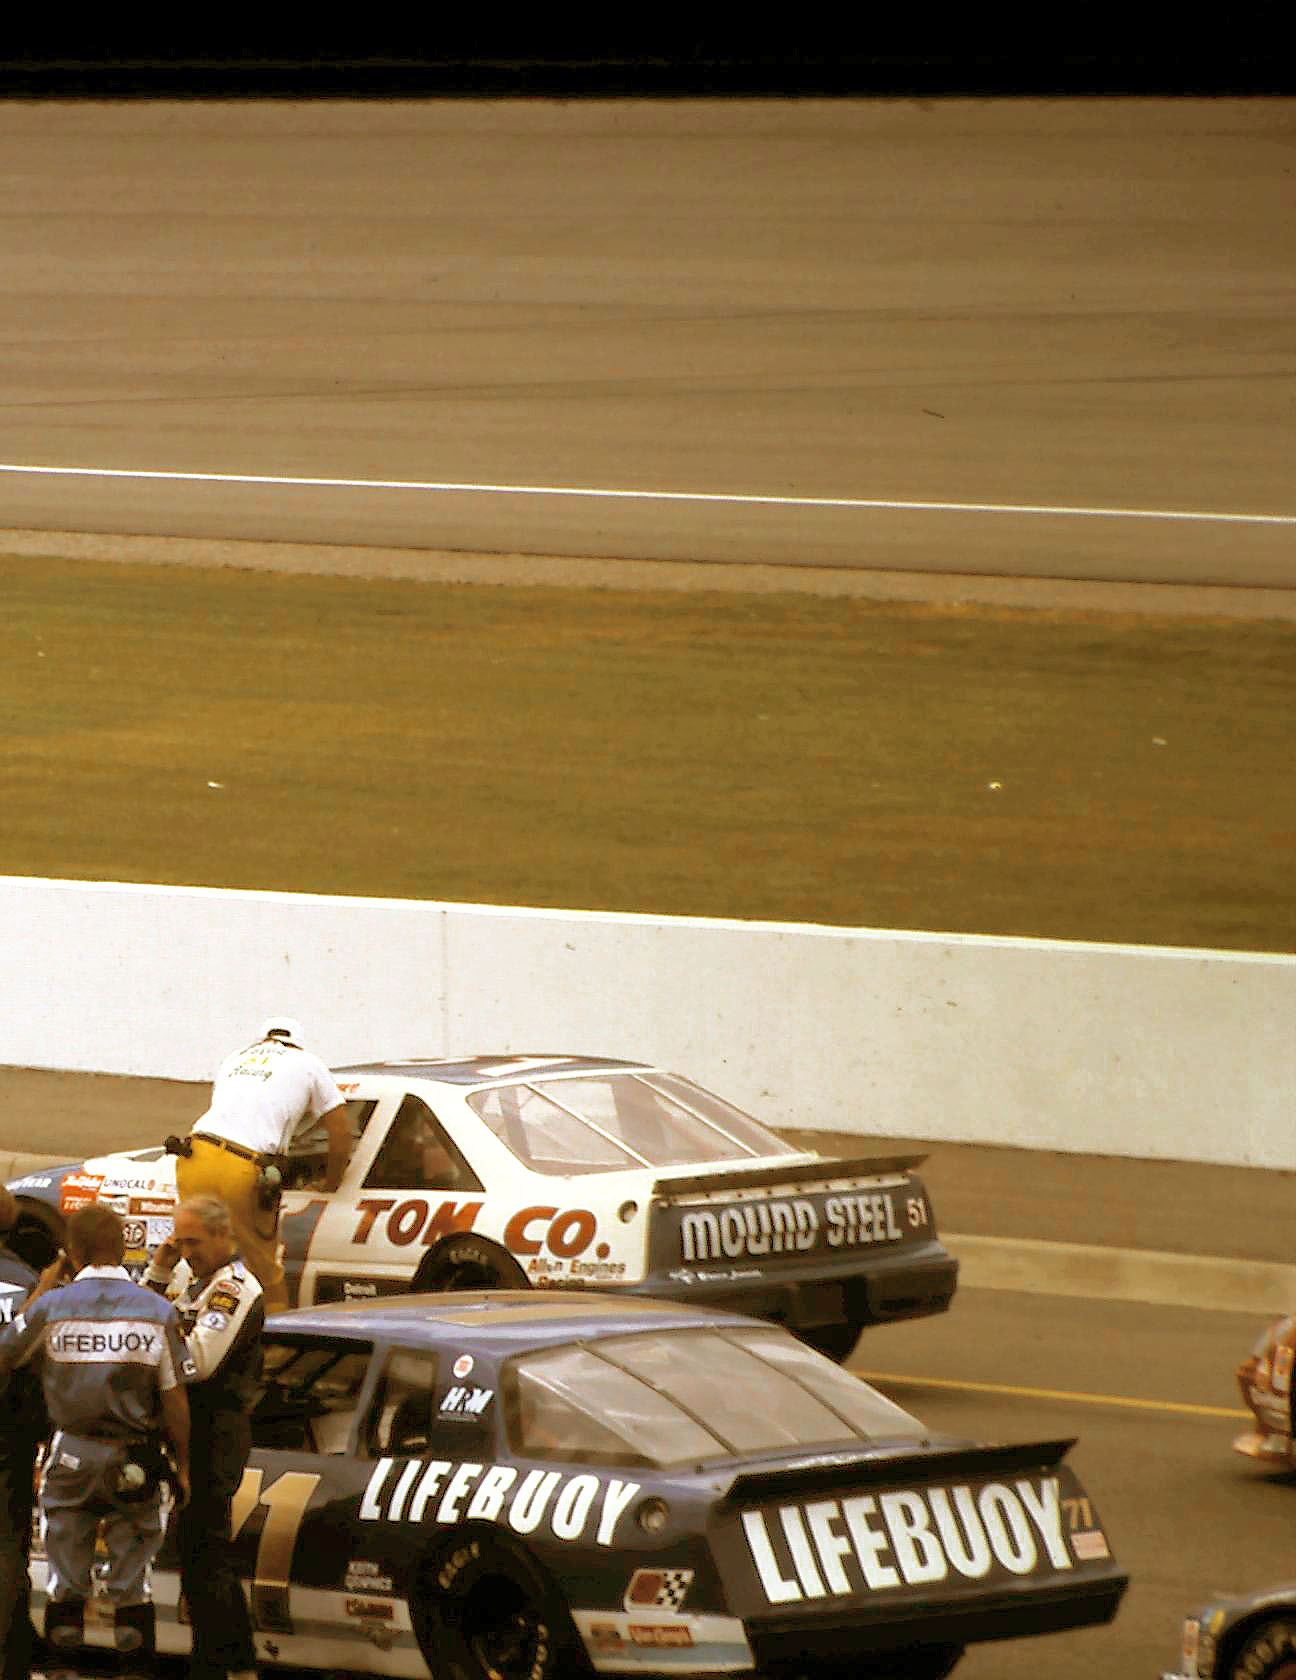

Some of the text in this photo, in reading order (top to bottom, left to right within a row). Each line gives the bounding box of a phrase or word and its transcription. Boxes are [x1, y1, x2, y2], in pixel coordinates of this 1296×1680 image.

[103, 1177, 149, 1190] UNOCAL
[906, 1198, 929, 1228] 51
[352, 1198, 611, 1260] TOM CO.
[680, 1194, 903, 1261] MOUND STEEL
[358, 1456, 642, 1546] LIFEBUOY
[1061, 1497, 1092, 1529] 71
[740, 1477, 1074, 1603] LIFEBUOY
